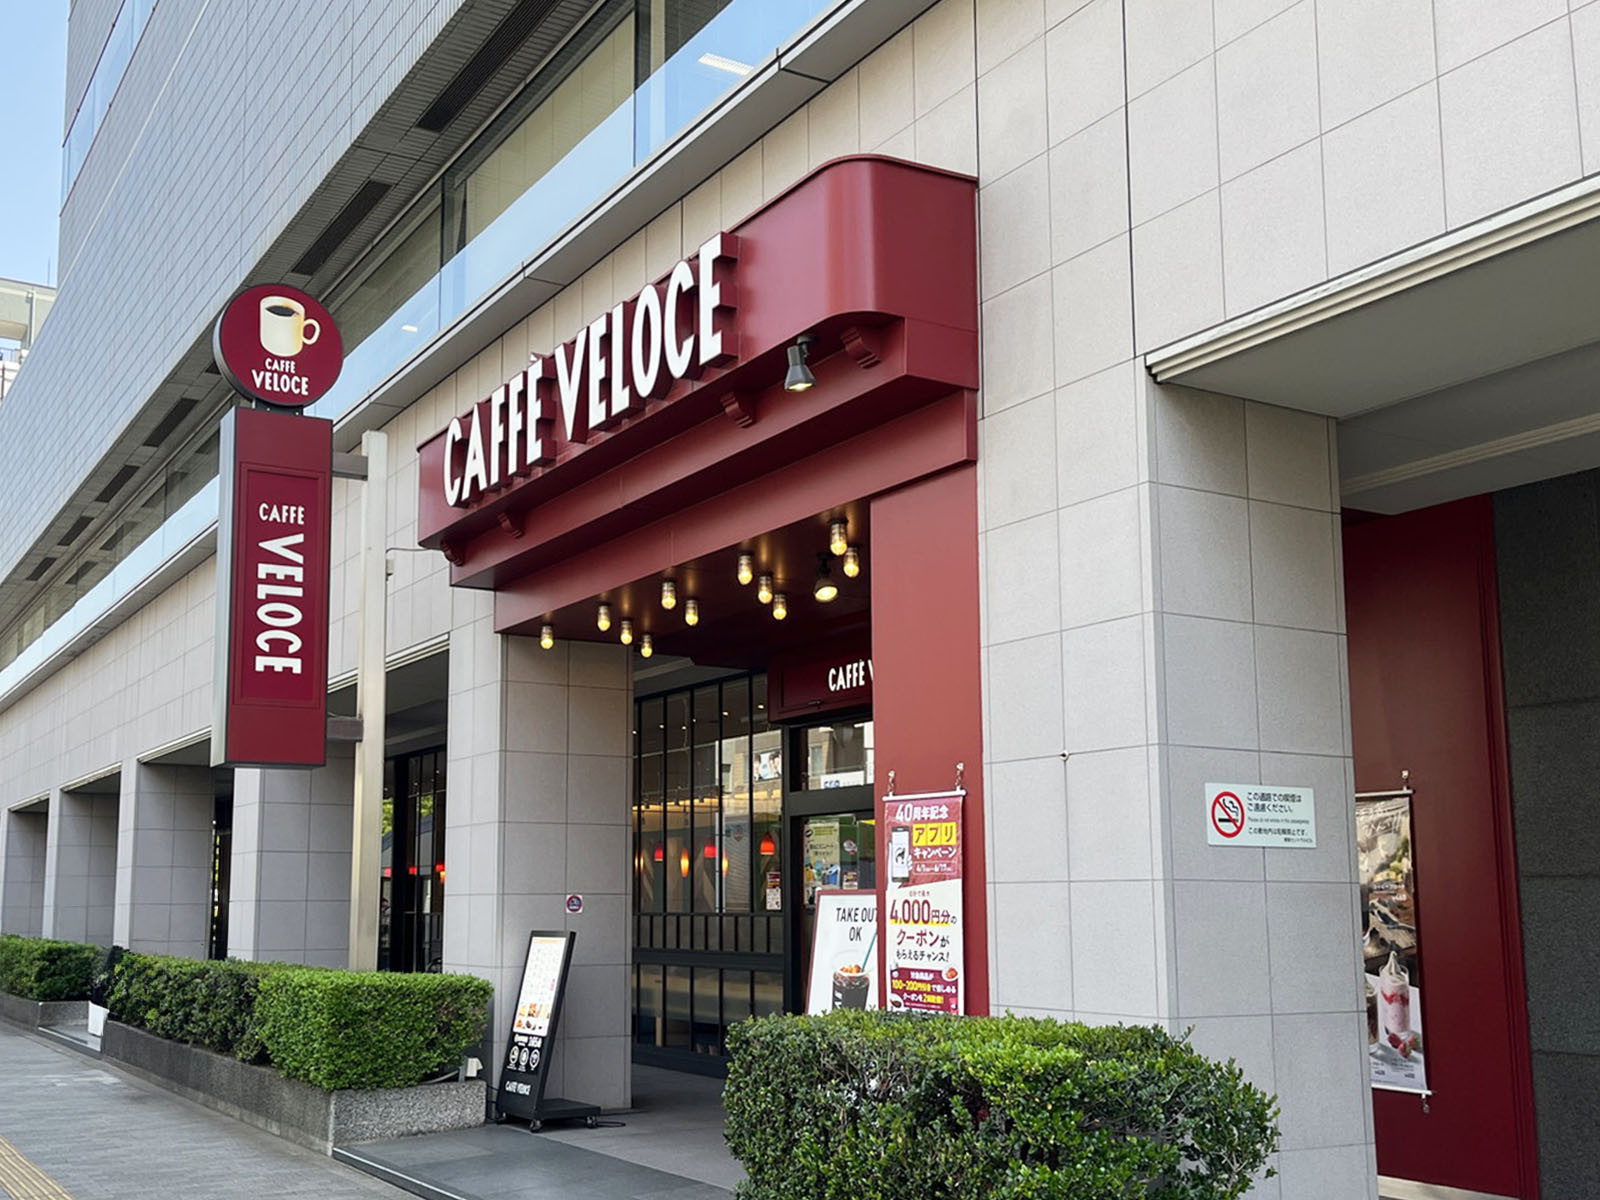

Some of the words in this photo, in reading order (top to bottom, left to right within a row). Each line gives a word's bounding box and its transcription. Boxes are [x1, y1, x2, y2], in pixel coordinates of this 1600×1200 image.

[554, 231, 723, 442] VELOCE
[251, 369, 309, 396] VELOCE
[255, 533, 305, 674] VELOCE
[896, 803, 949, 822] 40周年記念
[914, 824, 954, 844] アプリ
[913, 847, 957, 860] キャンペーン
[836, 907, 859, 922] TAKE
[849, 926, 862, 941] OK
[896, 927, 950, 948] クーポンが
